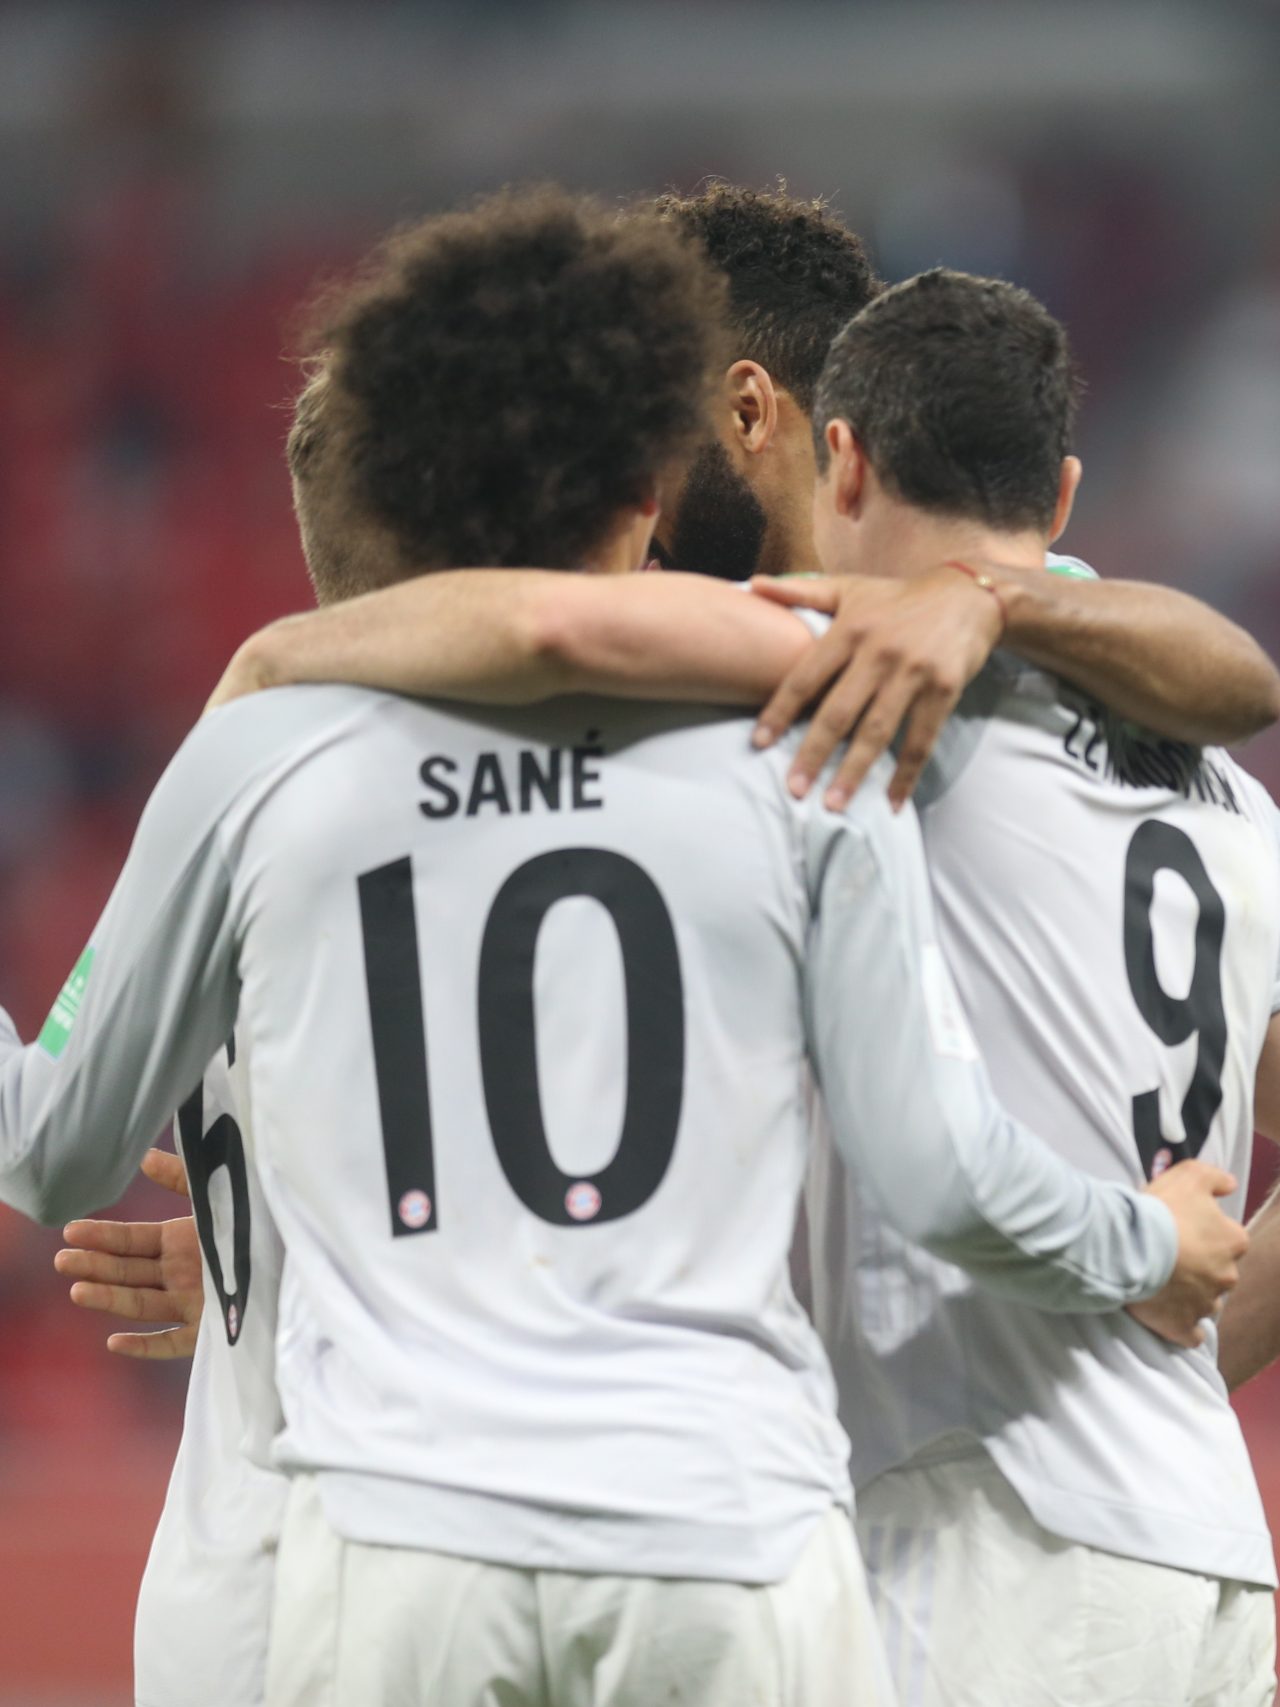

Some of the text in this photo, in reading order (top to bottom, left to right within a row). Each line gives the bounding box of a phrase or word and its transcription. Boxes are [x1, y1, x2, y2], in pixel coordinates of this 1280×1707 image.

[418, 729, 607, 820] SANÉ
[357, 846, 686, 1239] 10
[1124, 819, 1228, 1181] 9
